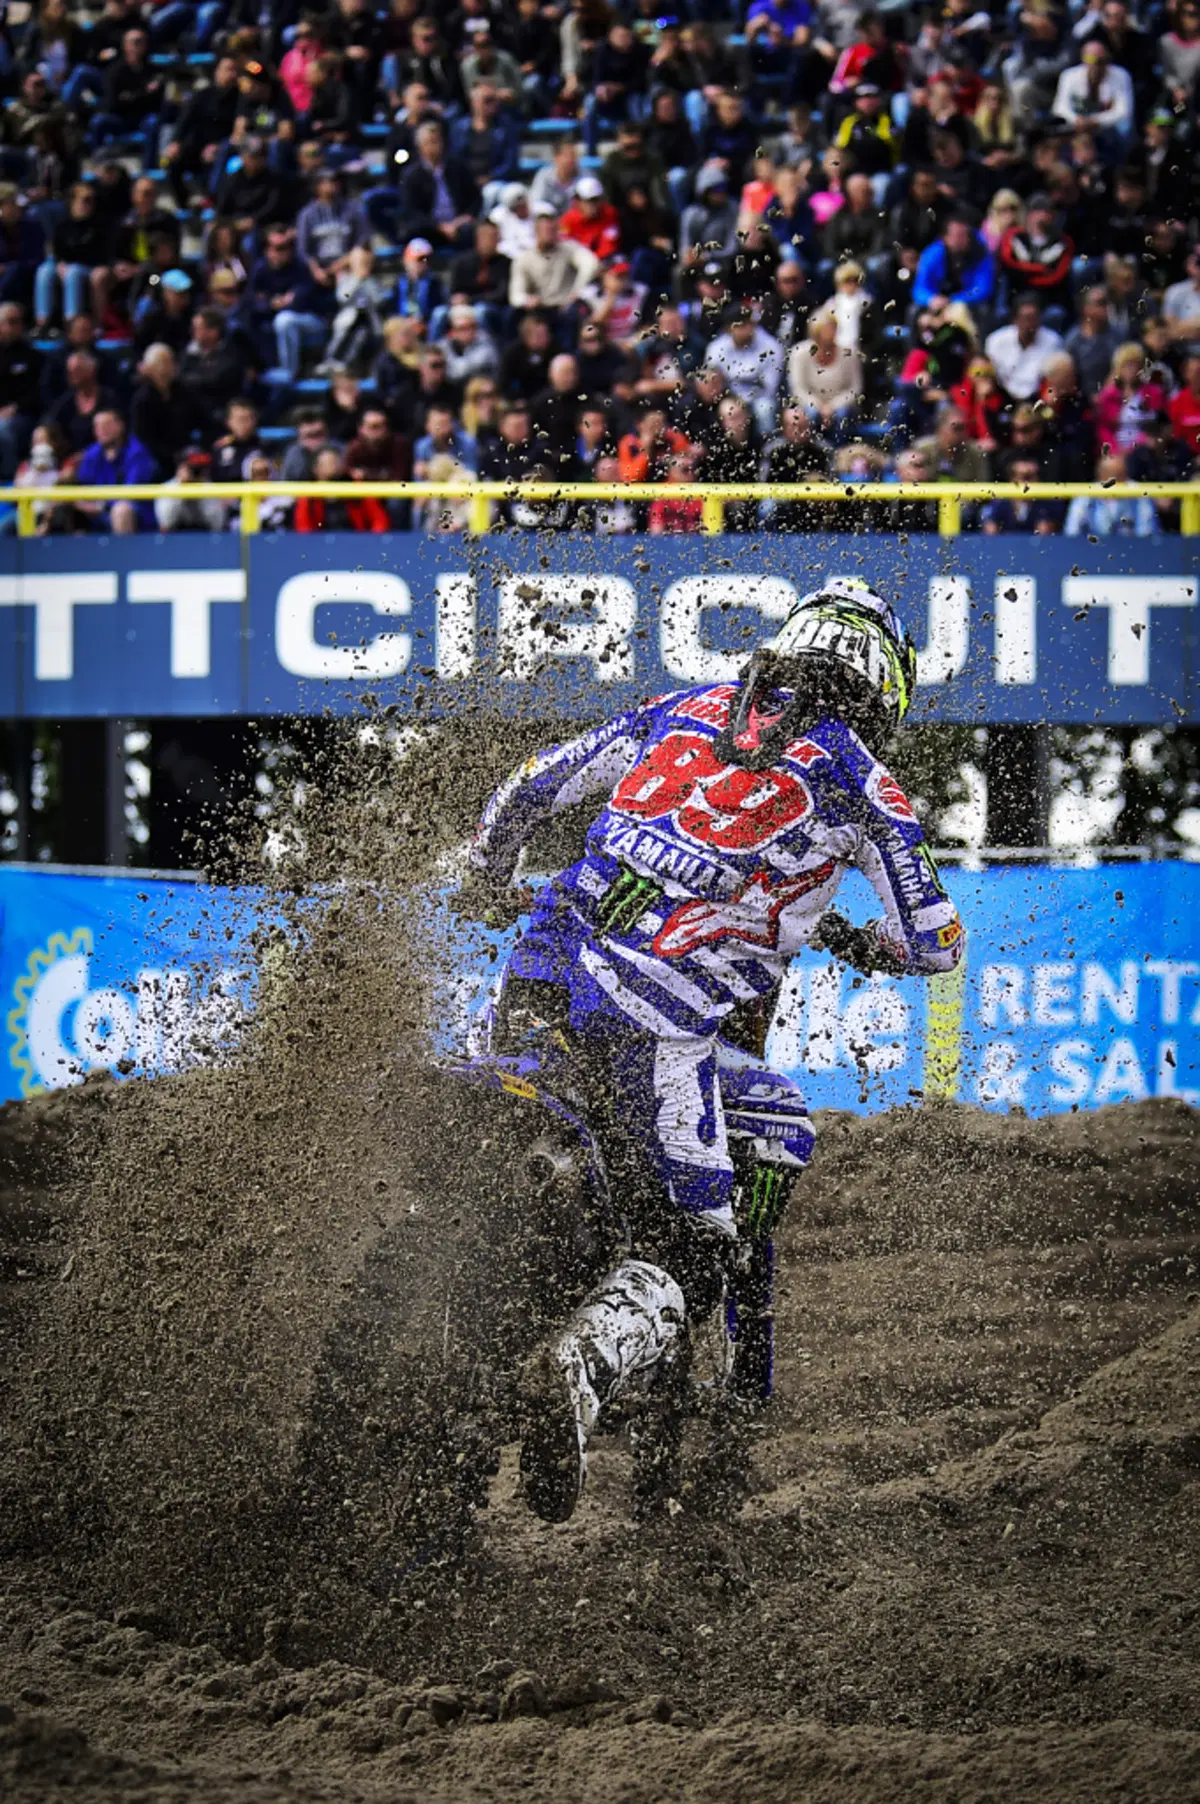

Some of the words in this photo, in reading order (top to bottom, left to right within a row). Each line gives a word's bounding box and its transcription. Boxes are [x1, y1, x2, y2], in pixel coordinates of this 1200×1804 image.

[0, 570, 246, 680] TT
[608, 731, 816, 855] 89
[979, 962, 1200, 1025] RENT
[976, 1041, 1029, 1102] &
